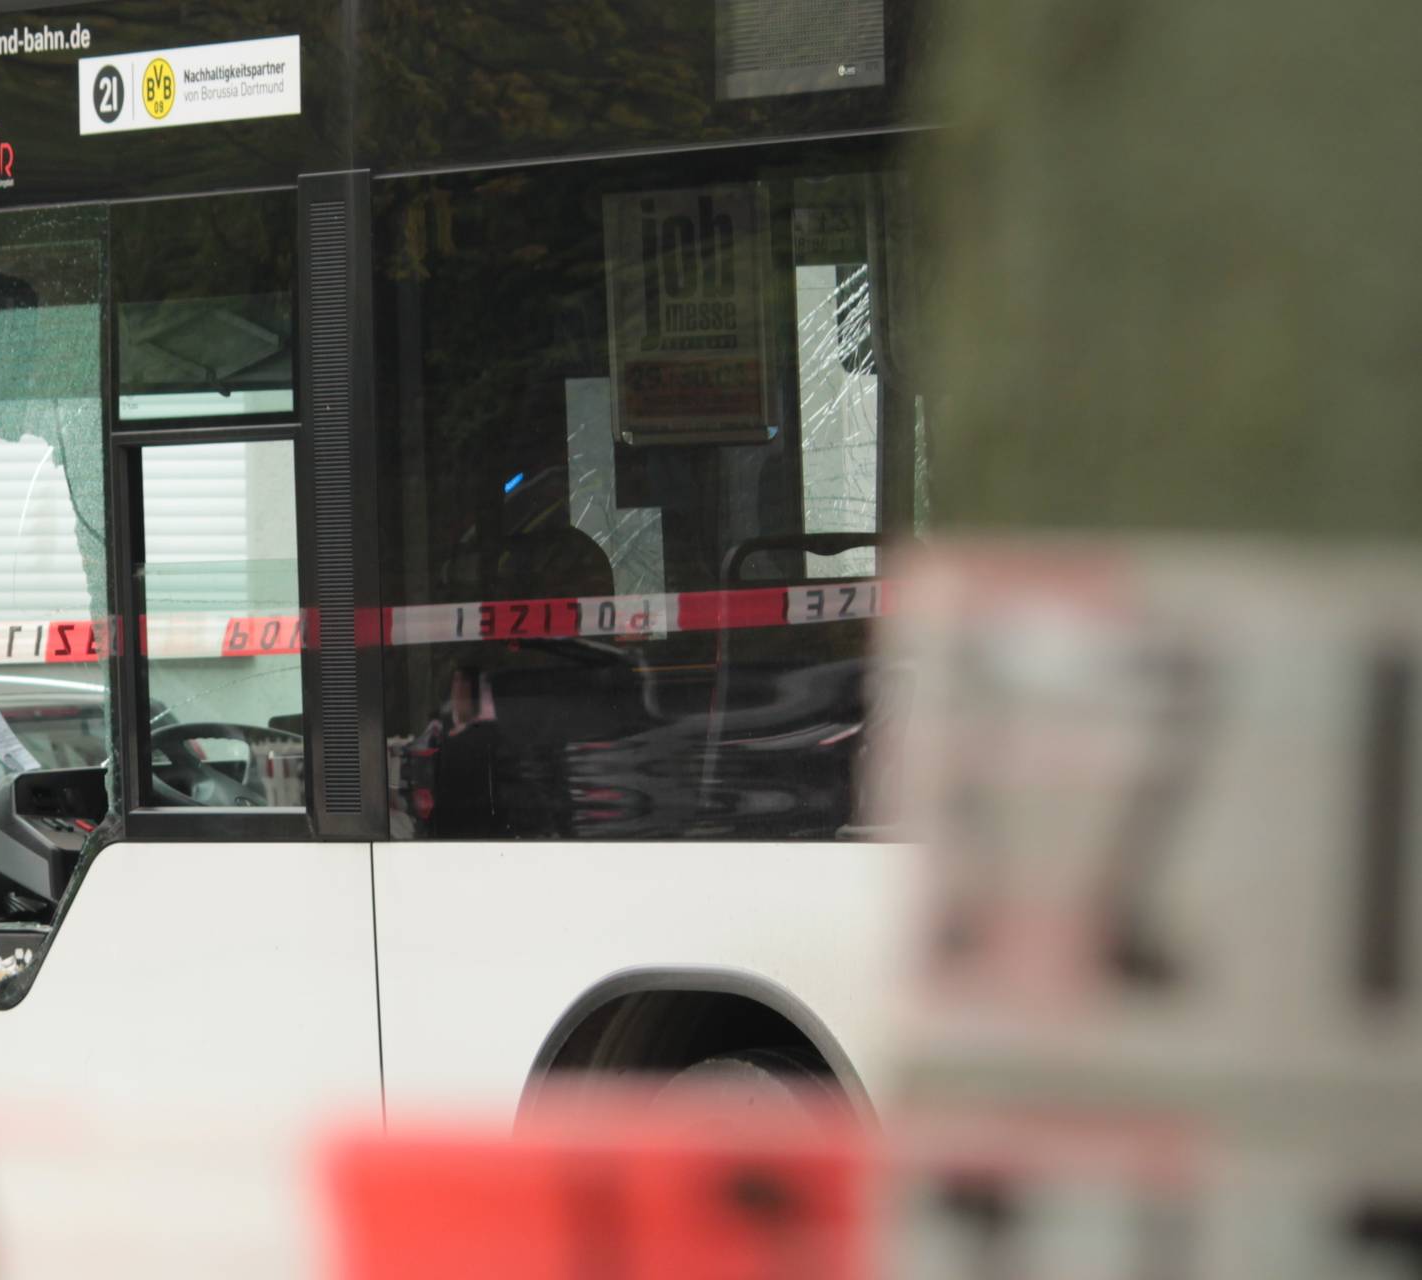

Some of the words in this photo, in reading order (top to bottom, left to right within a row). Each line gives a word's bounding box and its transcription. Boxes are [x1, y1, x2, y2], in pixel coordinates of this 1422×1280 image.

[146, 63, 173, 102] BVB
[183, 61, 286, 83] Nachhaltigkeitspartner
[183, 90, 200, 103] von
[201, 83, 239, 101] Borussia
[240, 79, 285, 97] Dortmund
[665, 302, 737, 332] messe
[455, 600, 650, 638] POLIZEI
